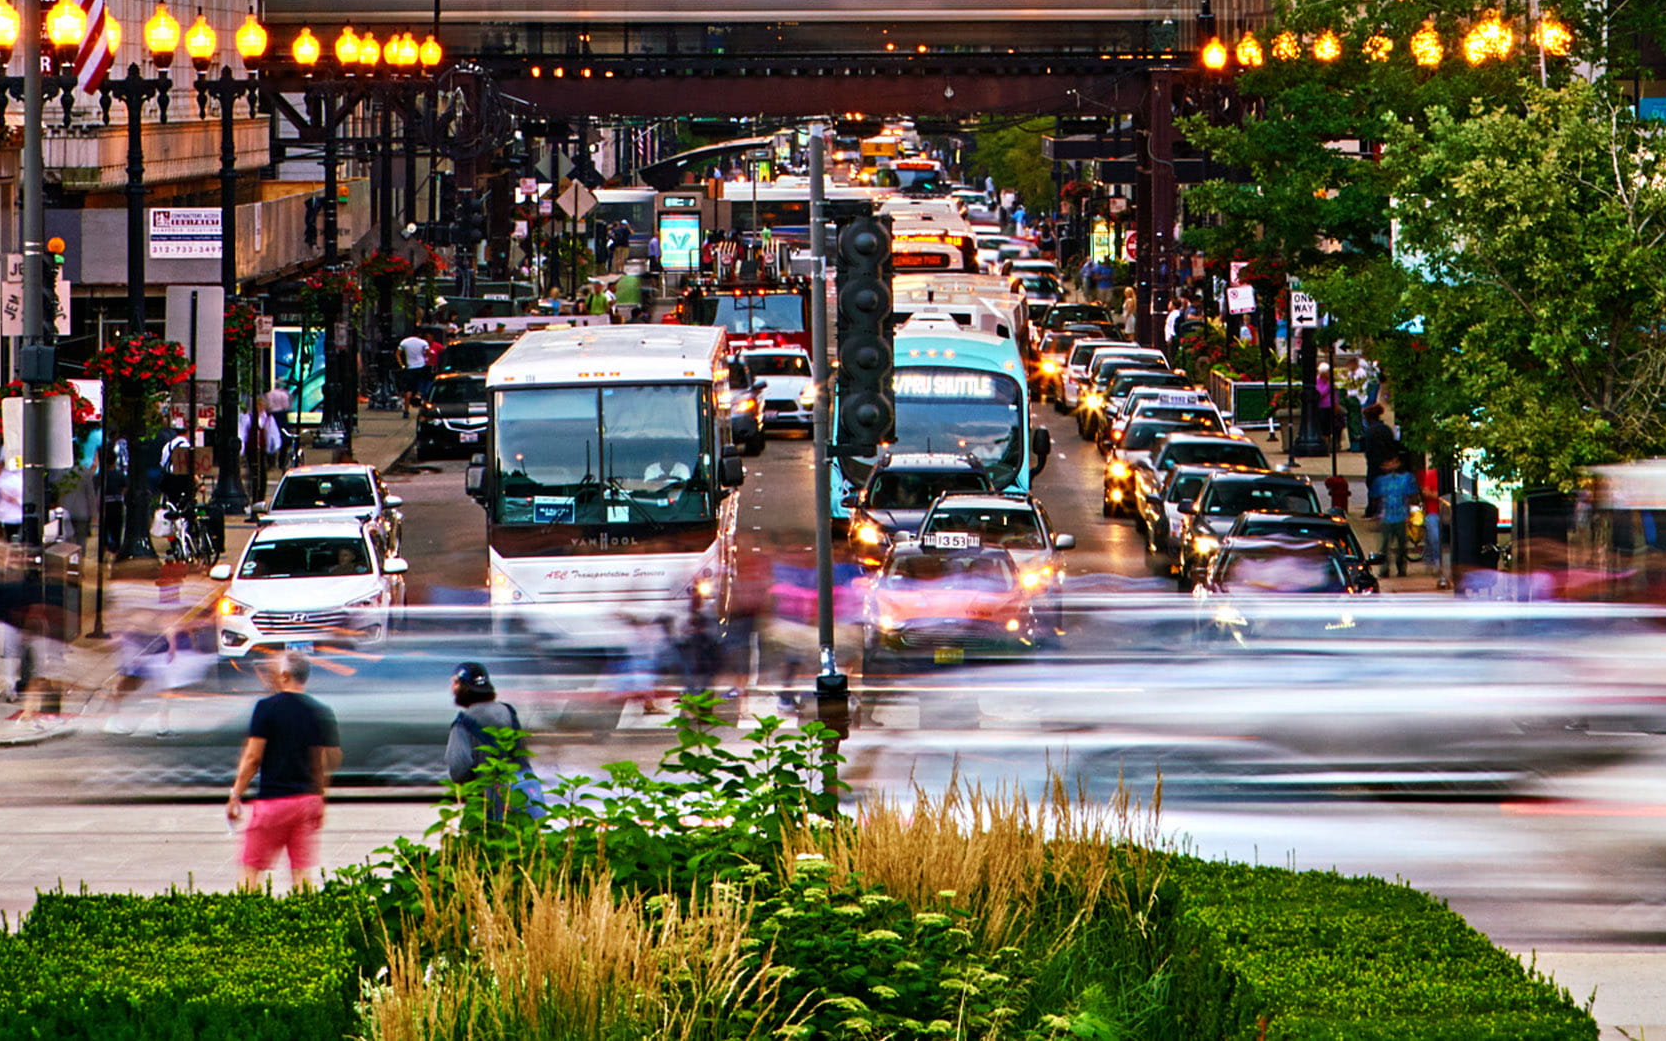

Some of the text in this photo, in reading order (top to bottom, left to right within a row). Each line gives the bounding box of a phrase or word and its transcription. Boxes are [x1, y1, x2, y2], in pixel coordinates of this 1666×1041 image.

[1294, 304, 1314, 313] WAY
[934, 375, 993, 396] SHUTTLE
[938, 536, 966, 547] 1353
